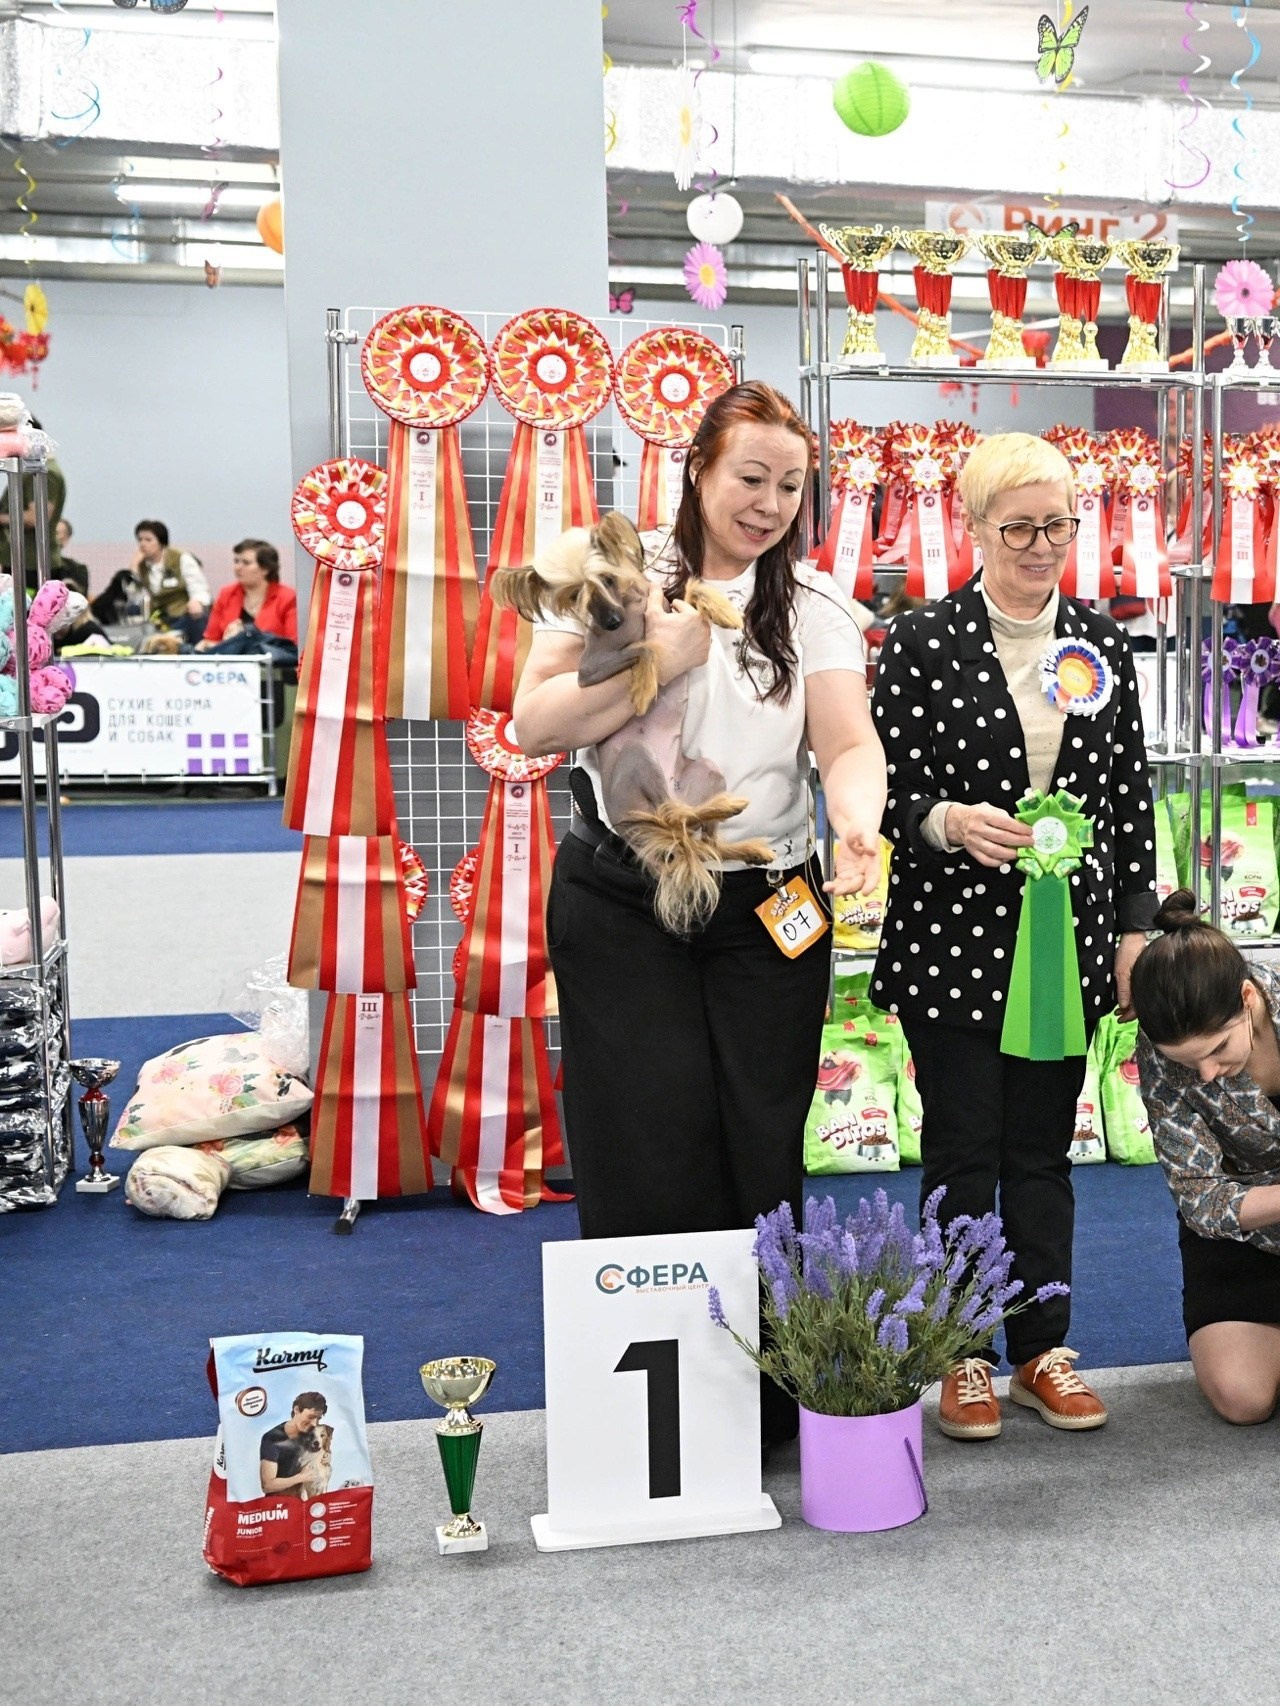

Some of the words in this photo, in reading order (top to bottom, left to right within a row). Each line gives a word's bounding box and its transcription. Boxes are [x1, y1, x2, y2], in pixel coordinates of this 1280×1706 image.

[185, 669, 248, 686] СФЕРА
[107, 698, 154, 711] СУХИЕ
[166, 698, 212, 710] КОРМА
[107, 713, 136, 728] ДЛЯ
[146, 714, 193, 727] КОШЕК
[108, 731, 117, 743] И
[127, 731, 175, 743] СОБАК
[1222, 900, 1261, 920] ITOS
[361, 1002, 378, 1012] III
[814, 1112, 858, 1143] BAN
[830, 1122, 888, 1151] DITOS
[595, 1261, 709, 1295] СФЕРА
[635, 1284, 687, 1294] ВЫСТАВОЧНЫЙ
[687, 1283, 710, 1291] ЦЕНТР
[253, 1347, 328, 1373] Karmy
[613, 1339, 681, 1499] 1
[237, 1508, 289, 1526] MEDIUM
[236, 1526, 264, 1536] JUNIOR
